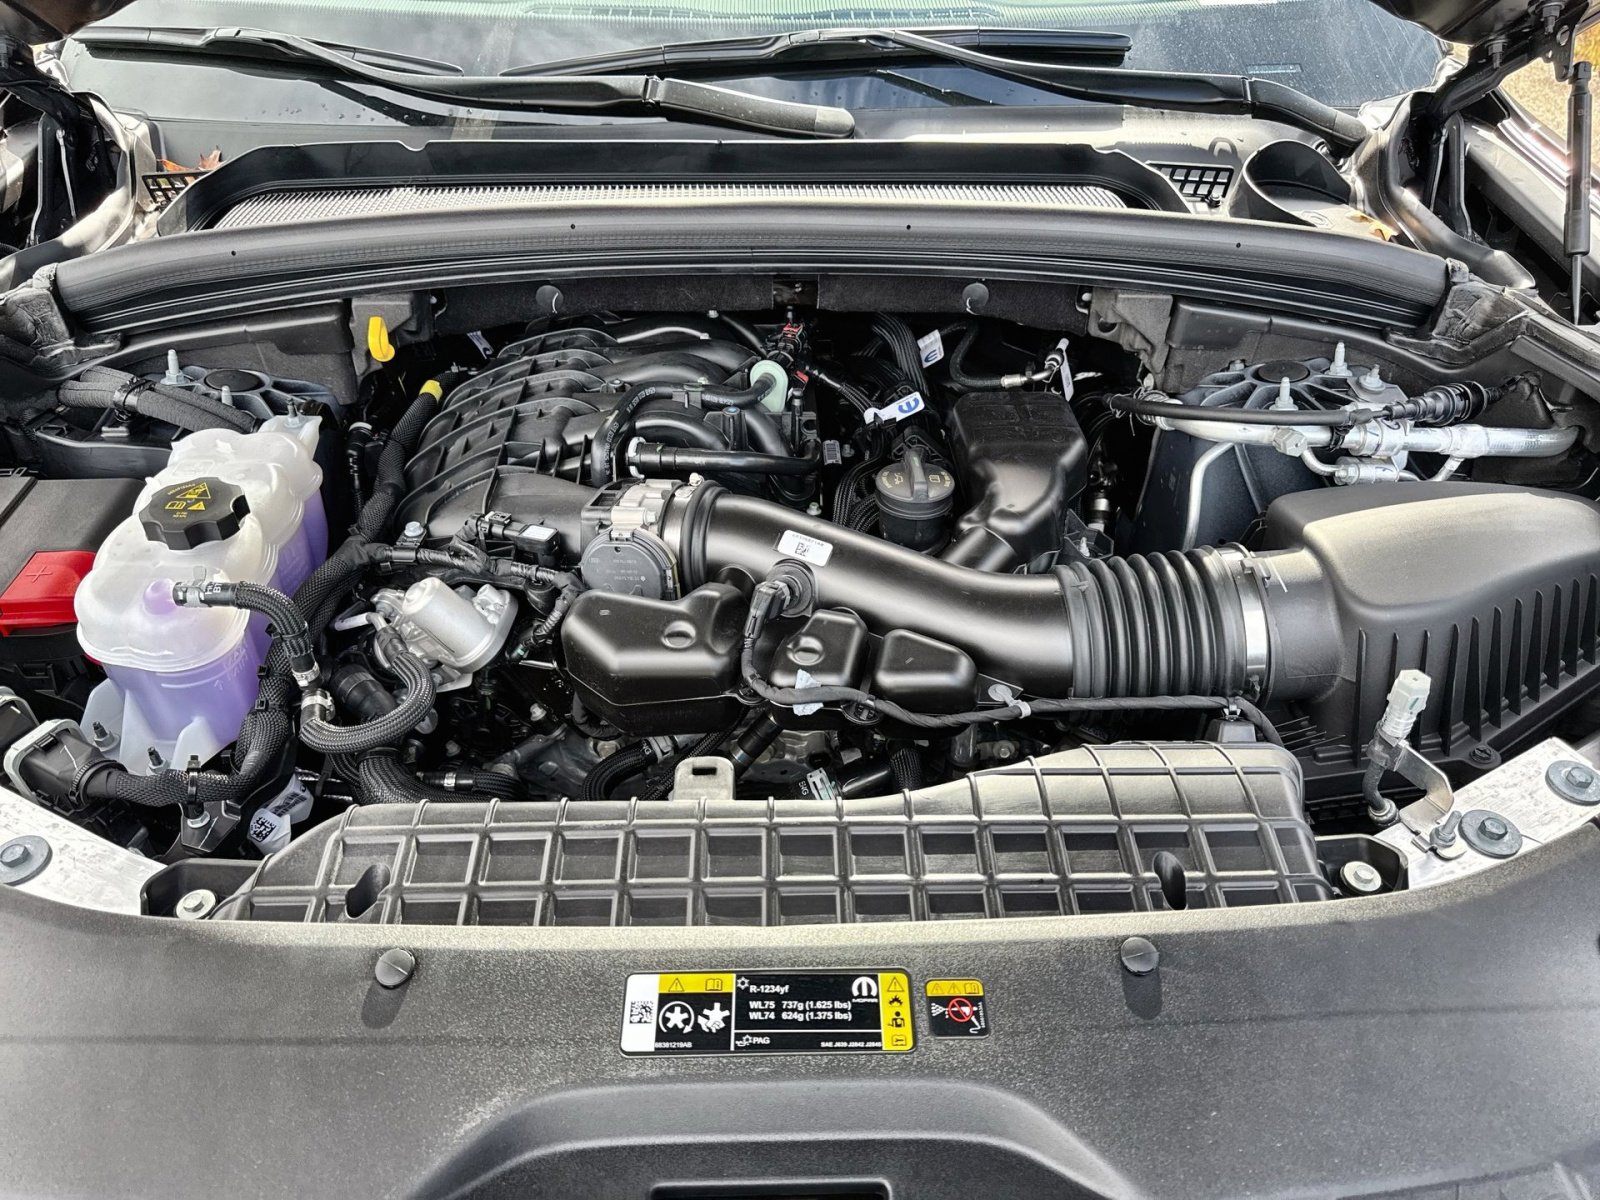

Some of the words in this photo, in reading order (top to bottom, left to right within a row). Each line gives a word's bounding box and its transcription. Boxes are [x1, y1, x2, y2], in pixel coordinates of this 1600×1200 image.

[749, 984, 790, 995] R-1234yf
[749, 1000, 776, 1009] WL75
[781, 1000, 804, 1011] 737g
[805, 1000, 833, 1011] (1.625
[834, 1000, 852, 1011] lbs)
[749, 1011, 776, 1020] WL74
[781, 1011, 804, 1022] 624g
[805, 1011, 833, 1022] (1.375
[834, 1011, 852, 1022] lbs)
[752, 1036, 770, 1045] PAG
